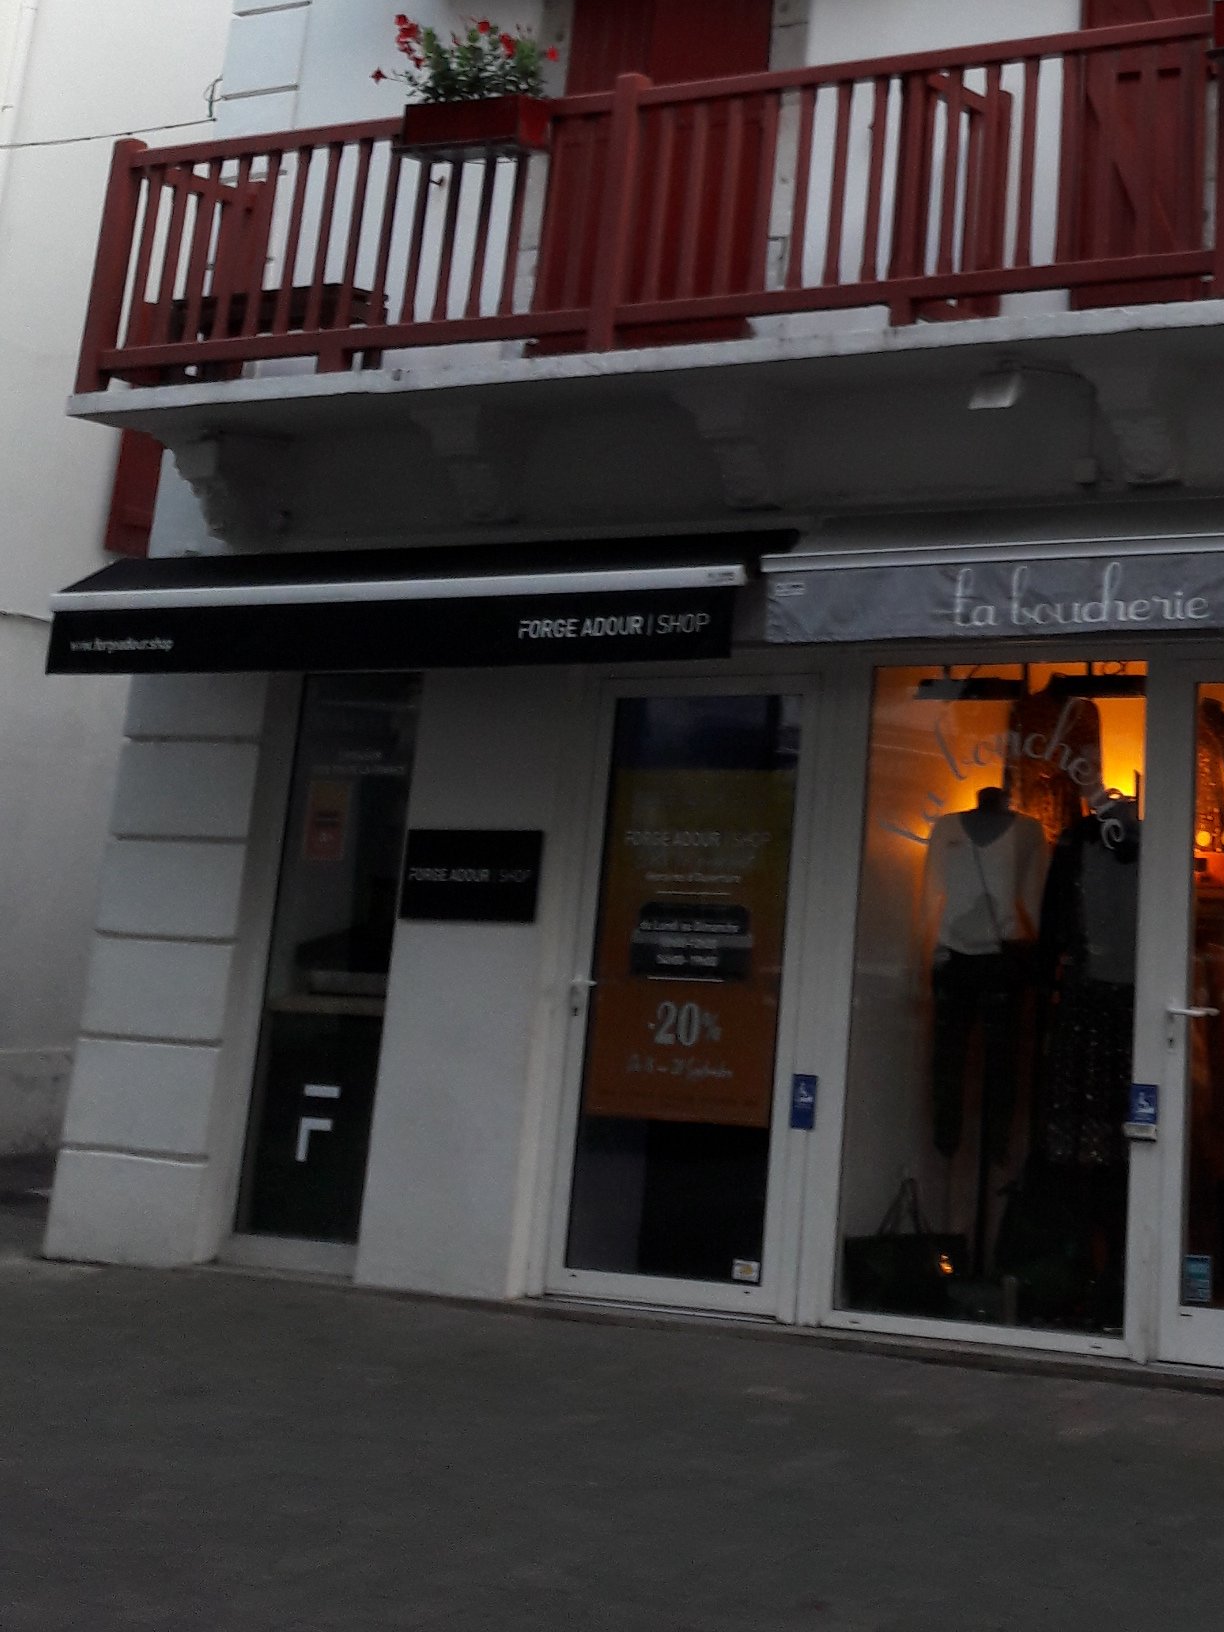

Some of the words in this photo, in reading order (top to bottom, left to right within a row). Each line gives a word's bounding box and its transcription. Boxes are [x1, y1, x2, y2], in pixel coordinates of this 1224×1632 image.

[1009, 562, 1214, 626] boucherie
[517, 618, 580, 641] FORGE
[579, 614, 646, 638] ADOUR
[654, 611, 712, 635] SHOP
[625, 830, 672, 847] FORGE
[672, 831, 720, 847] ADOUR
[408, 867, 448, 881] FORGE
[449, 868, 489, 882] ADOUR
[647, 1000, 722, 1046] -20%
